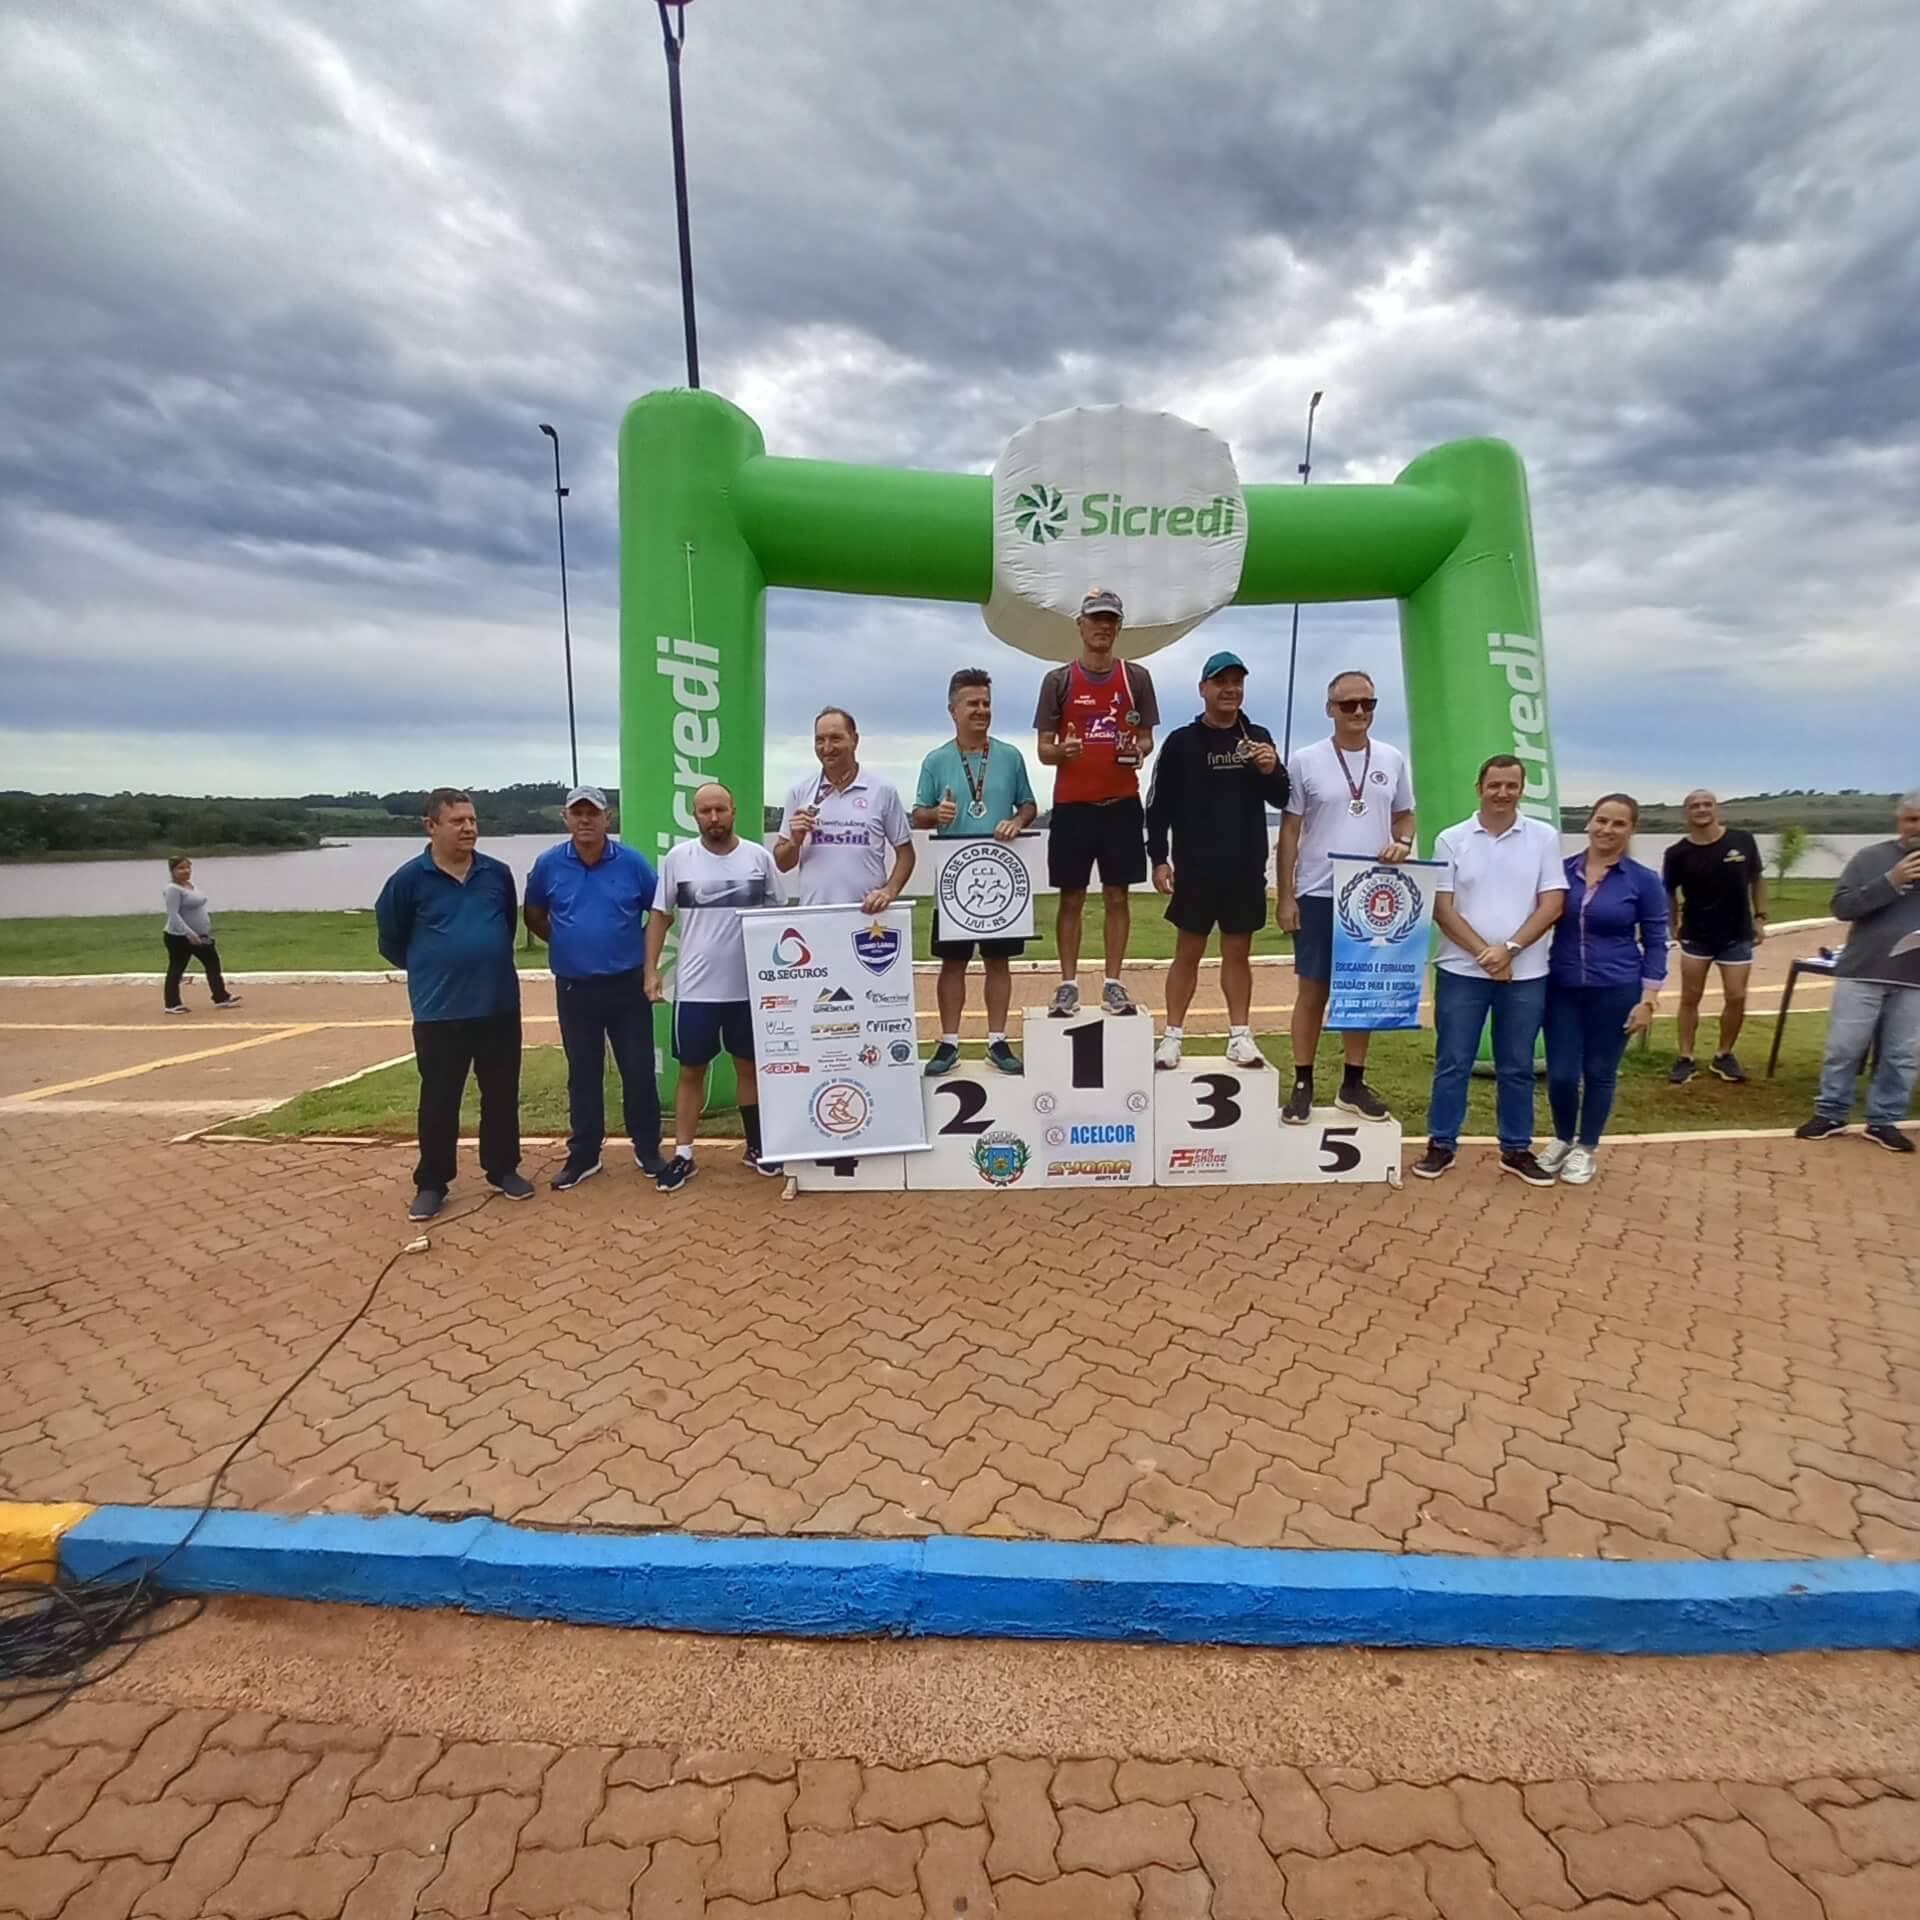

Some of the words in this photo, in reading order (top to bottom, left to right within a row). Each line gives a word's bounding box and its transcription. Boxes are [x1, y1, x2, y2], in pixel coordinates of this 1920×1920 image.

[1080, 493, 1234, 538] Sicredi
[656, 636, 720, 879] icredi
[942, 872, 955, 901] CLUBE
[949, 859, 963, 872] DE
[962, 847, 1026, 884] CORREDORES
[1015, 885, 1026, 898] DE
[993, 915, 1007, 927] RS
[777, 967, 828, 981] SEGUROS
[1367, 981, 1384, 991] PARA
[1374, 963, 1380, 973] E
[1062, 1019, 1104, 1089] 1
[934, 1079, 996, 1136] 2
[1186, 1073, 1242, 1130] 3
[1070, 1125, 1135, 1144] ACELCOR
[1318, 1127, 1362, 1173] 5
